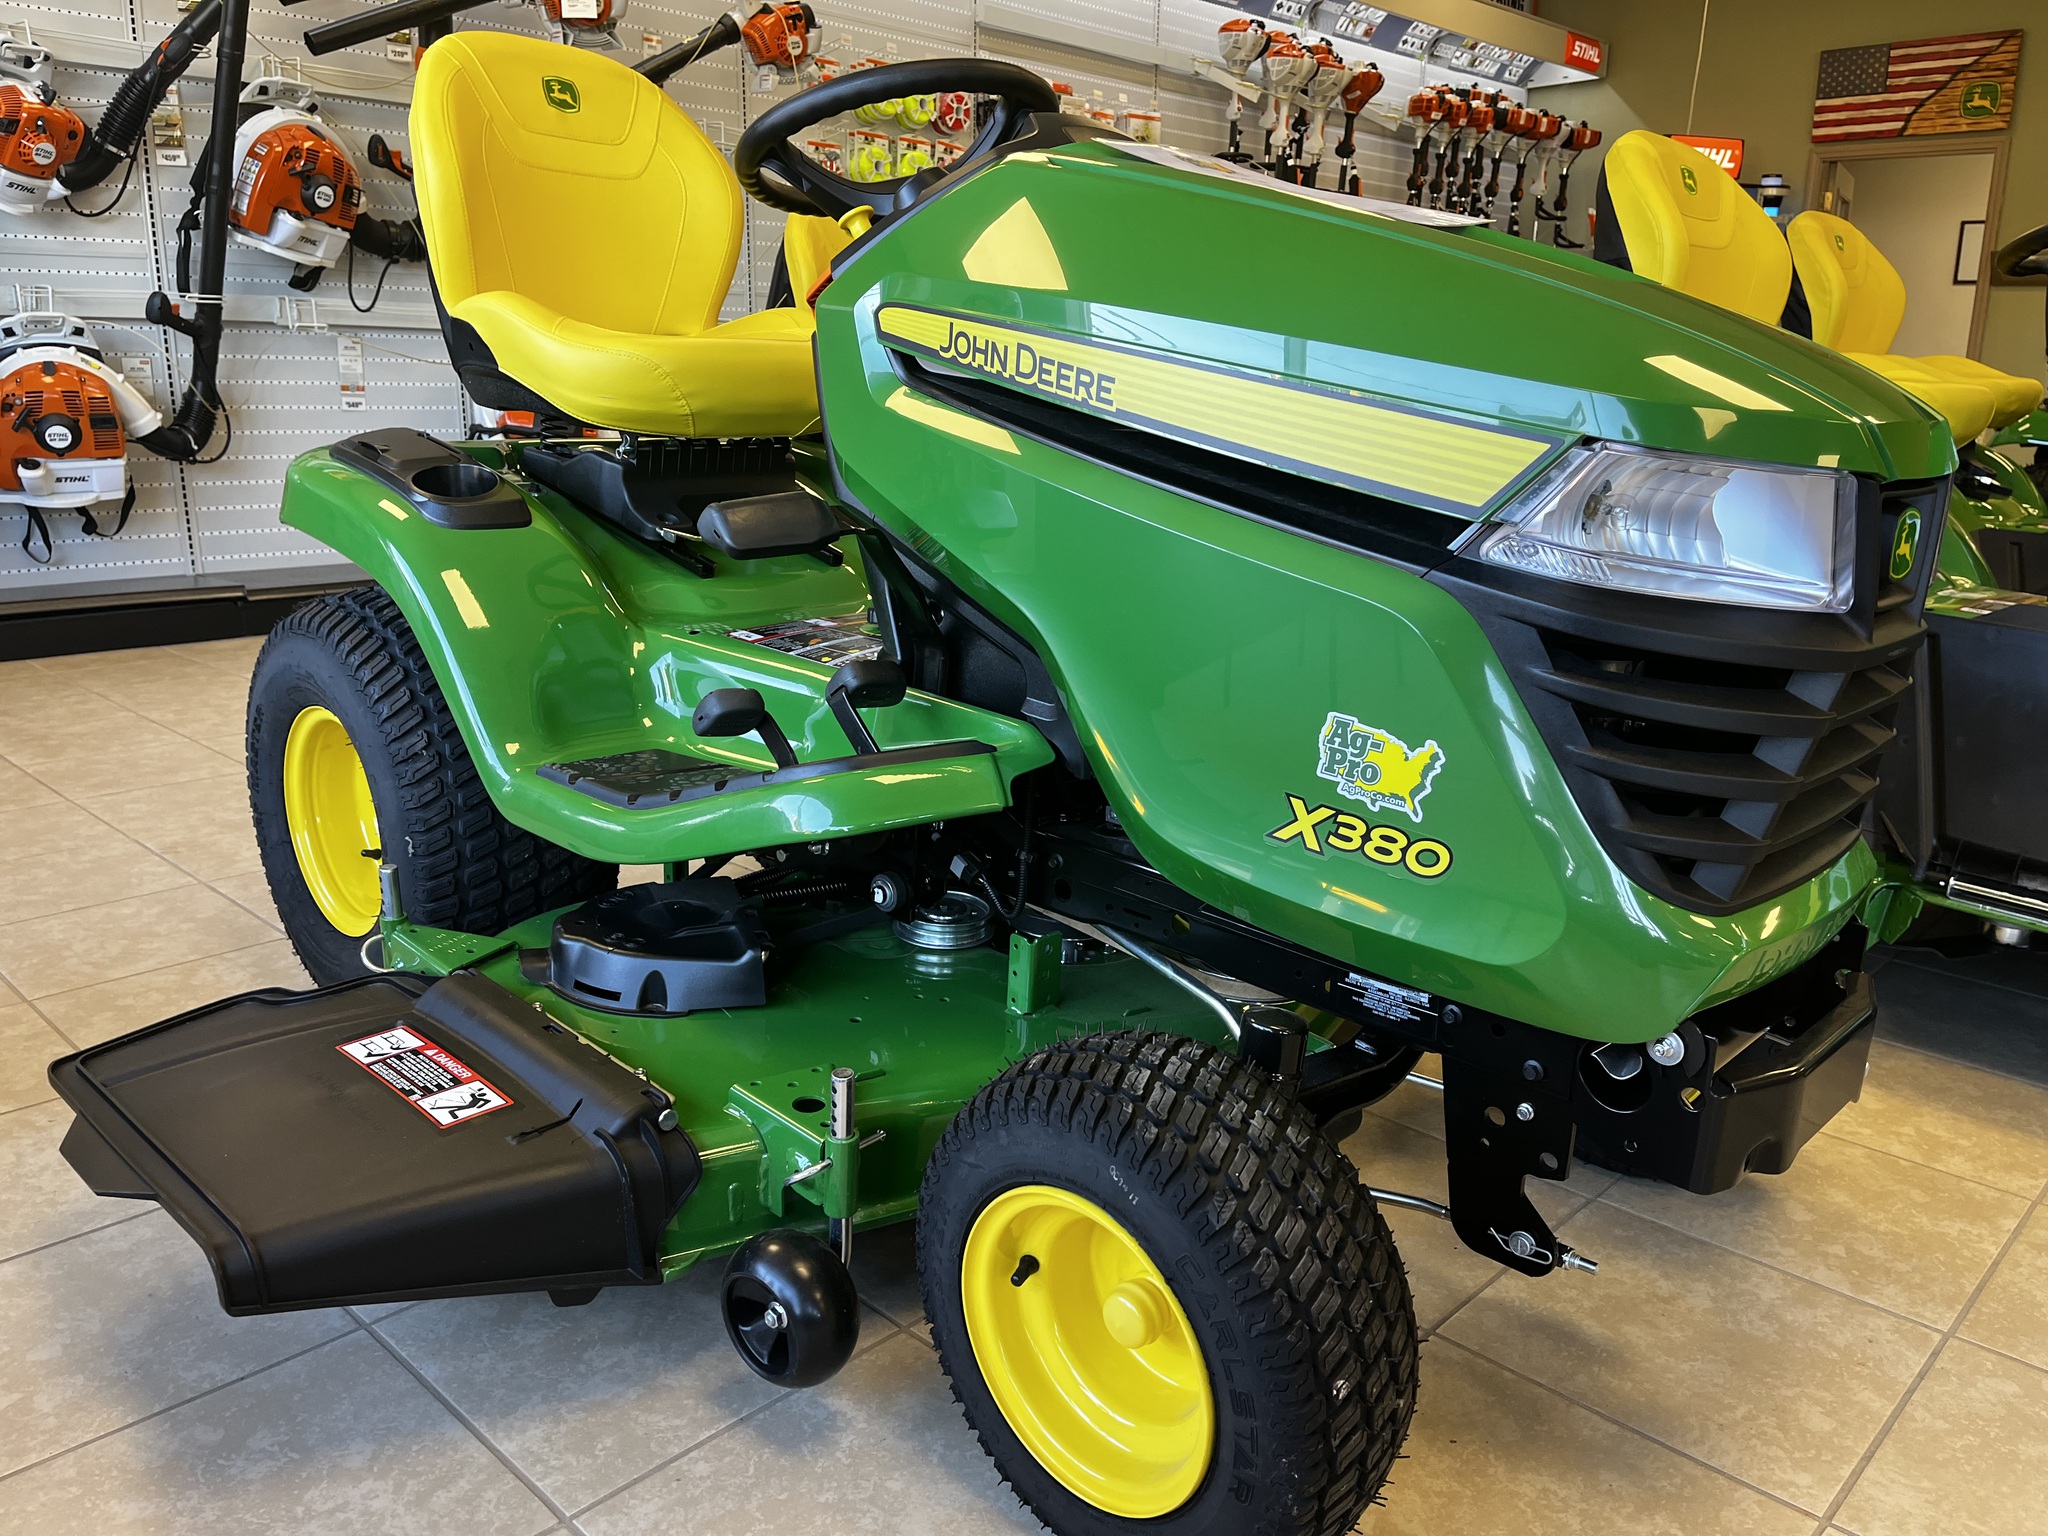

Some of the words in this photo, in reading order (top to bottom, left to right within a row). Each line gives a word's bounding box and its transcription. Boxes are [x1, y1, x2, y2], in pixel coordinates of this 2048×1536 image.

[1571, 40, 1601, 64] STIHL
[34, 147, 54, 156] STIHL
[5, 181, 37, 195] STIHL
[939, 321, 1009, 373] JOHN
[1015, 342, 1117, 407] DEERE
[54, 475, 87, 483] STIHL
[1326, 716, 1385, 760] Ag-
[1322, 746, 1382, 785] Pro
[1341, 783, 1406, 808] AgProCo.com
[1264, 791, 1454, 879] X380
[433, 1052, 473, 1080] DANGER
[1174, 1252, 1260, 1506] CARLSTAR
